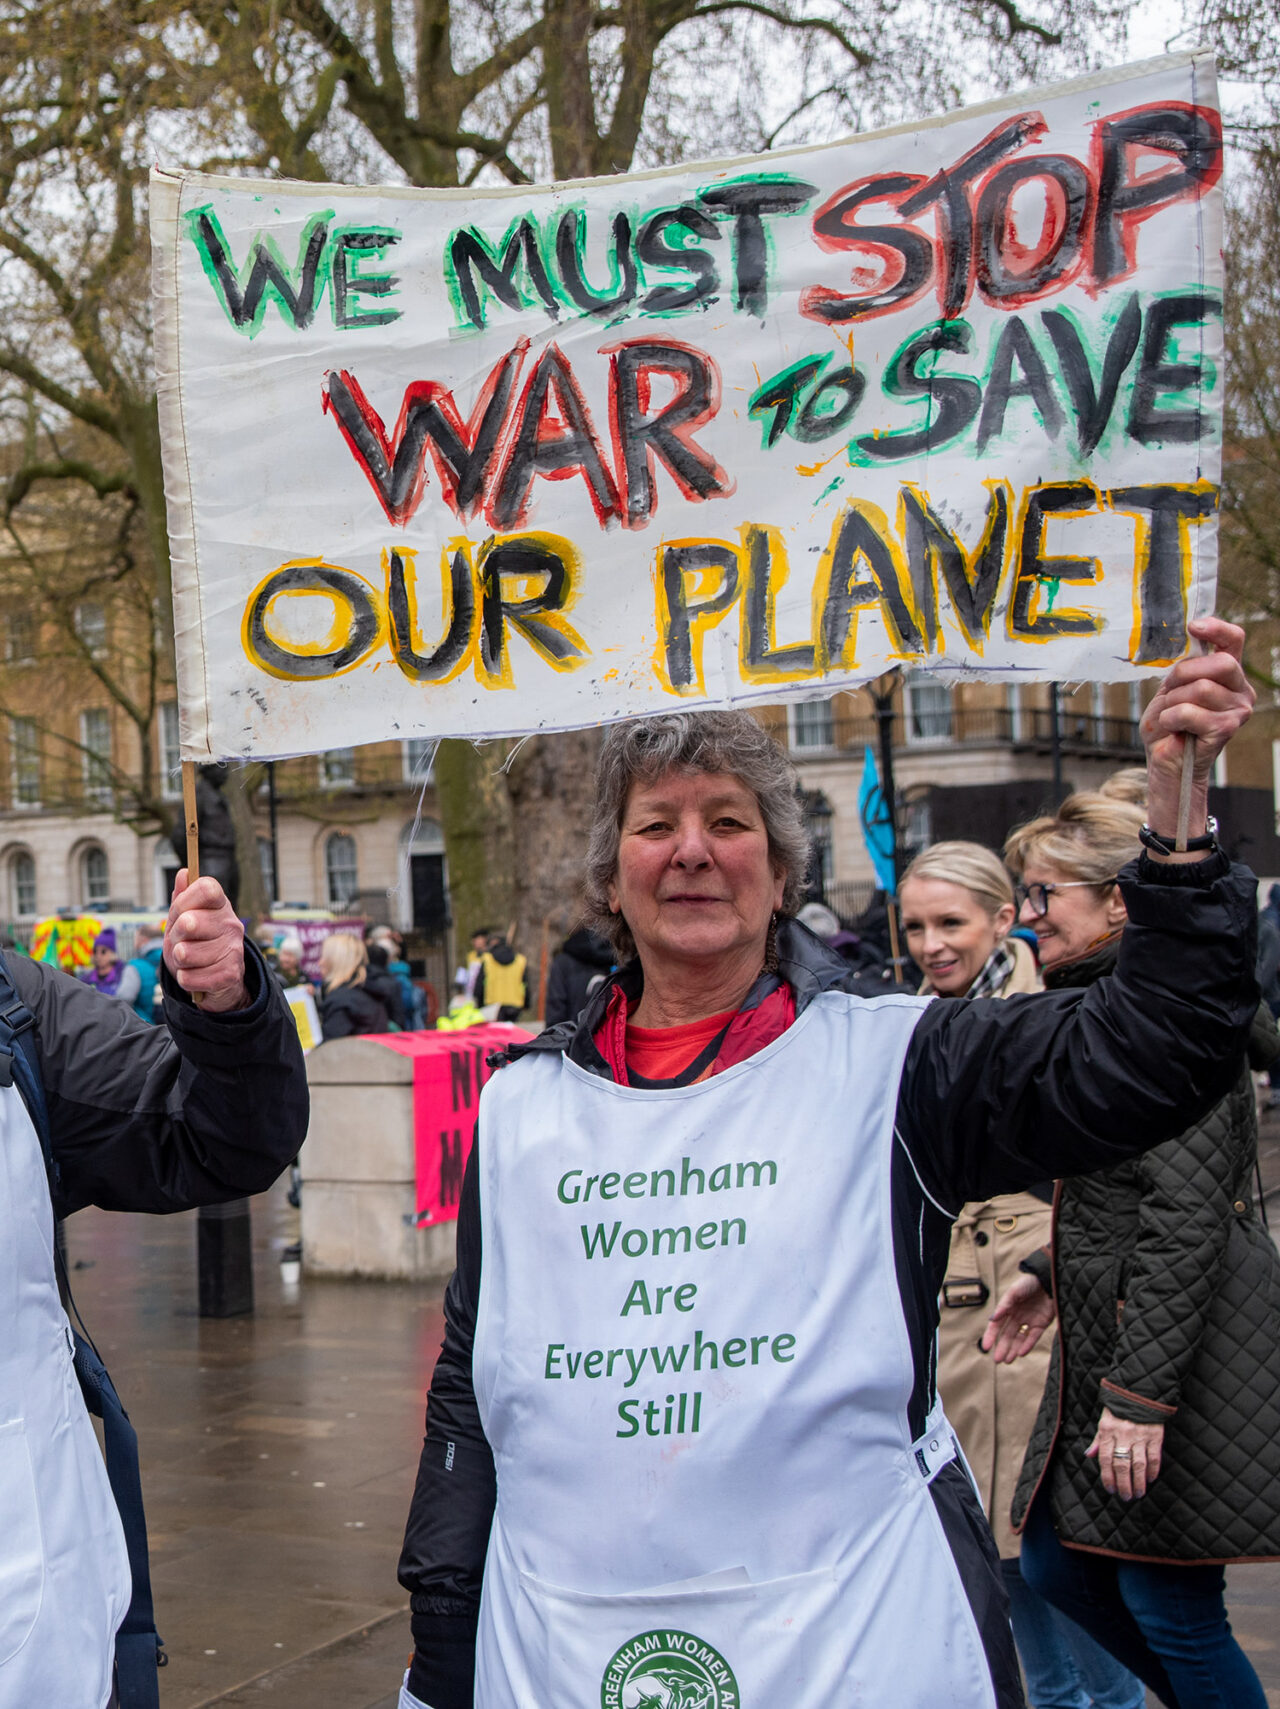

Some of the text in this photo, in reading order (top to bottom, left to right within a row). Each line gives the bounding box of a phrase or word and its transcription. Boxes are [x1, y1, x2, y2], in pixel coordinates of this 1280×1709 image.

[183, 100, 1222, 339] WE MUST STOP
[322, 284, 1222, 531] WAR TO SAVE
[241, 476, 1219, 697] OUR PLANET
[557, 1157, 777, 1204] Greenham
[580, 1218, 746, 1259] Women
[620, 1280, 697, 1316] Are
[544, 1330, 796, 1388] Everywhere
[616, 1392, 702, 1438] Still
[605, 1635, 661, 1709] REENHAM
[666, 1634, 731, 1686] WOMEN
